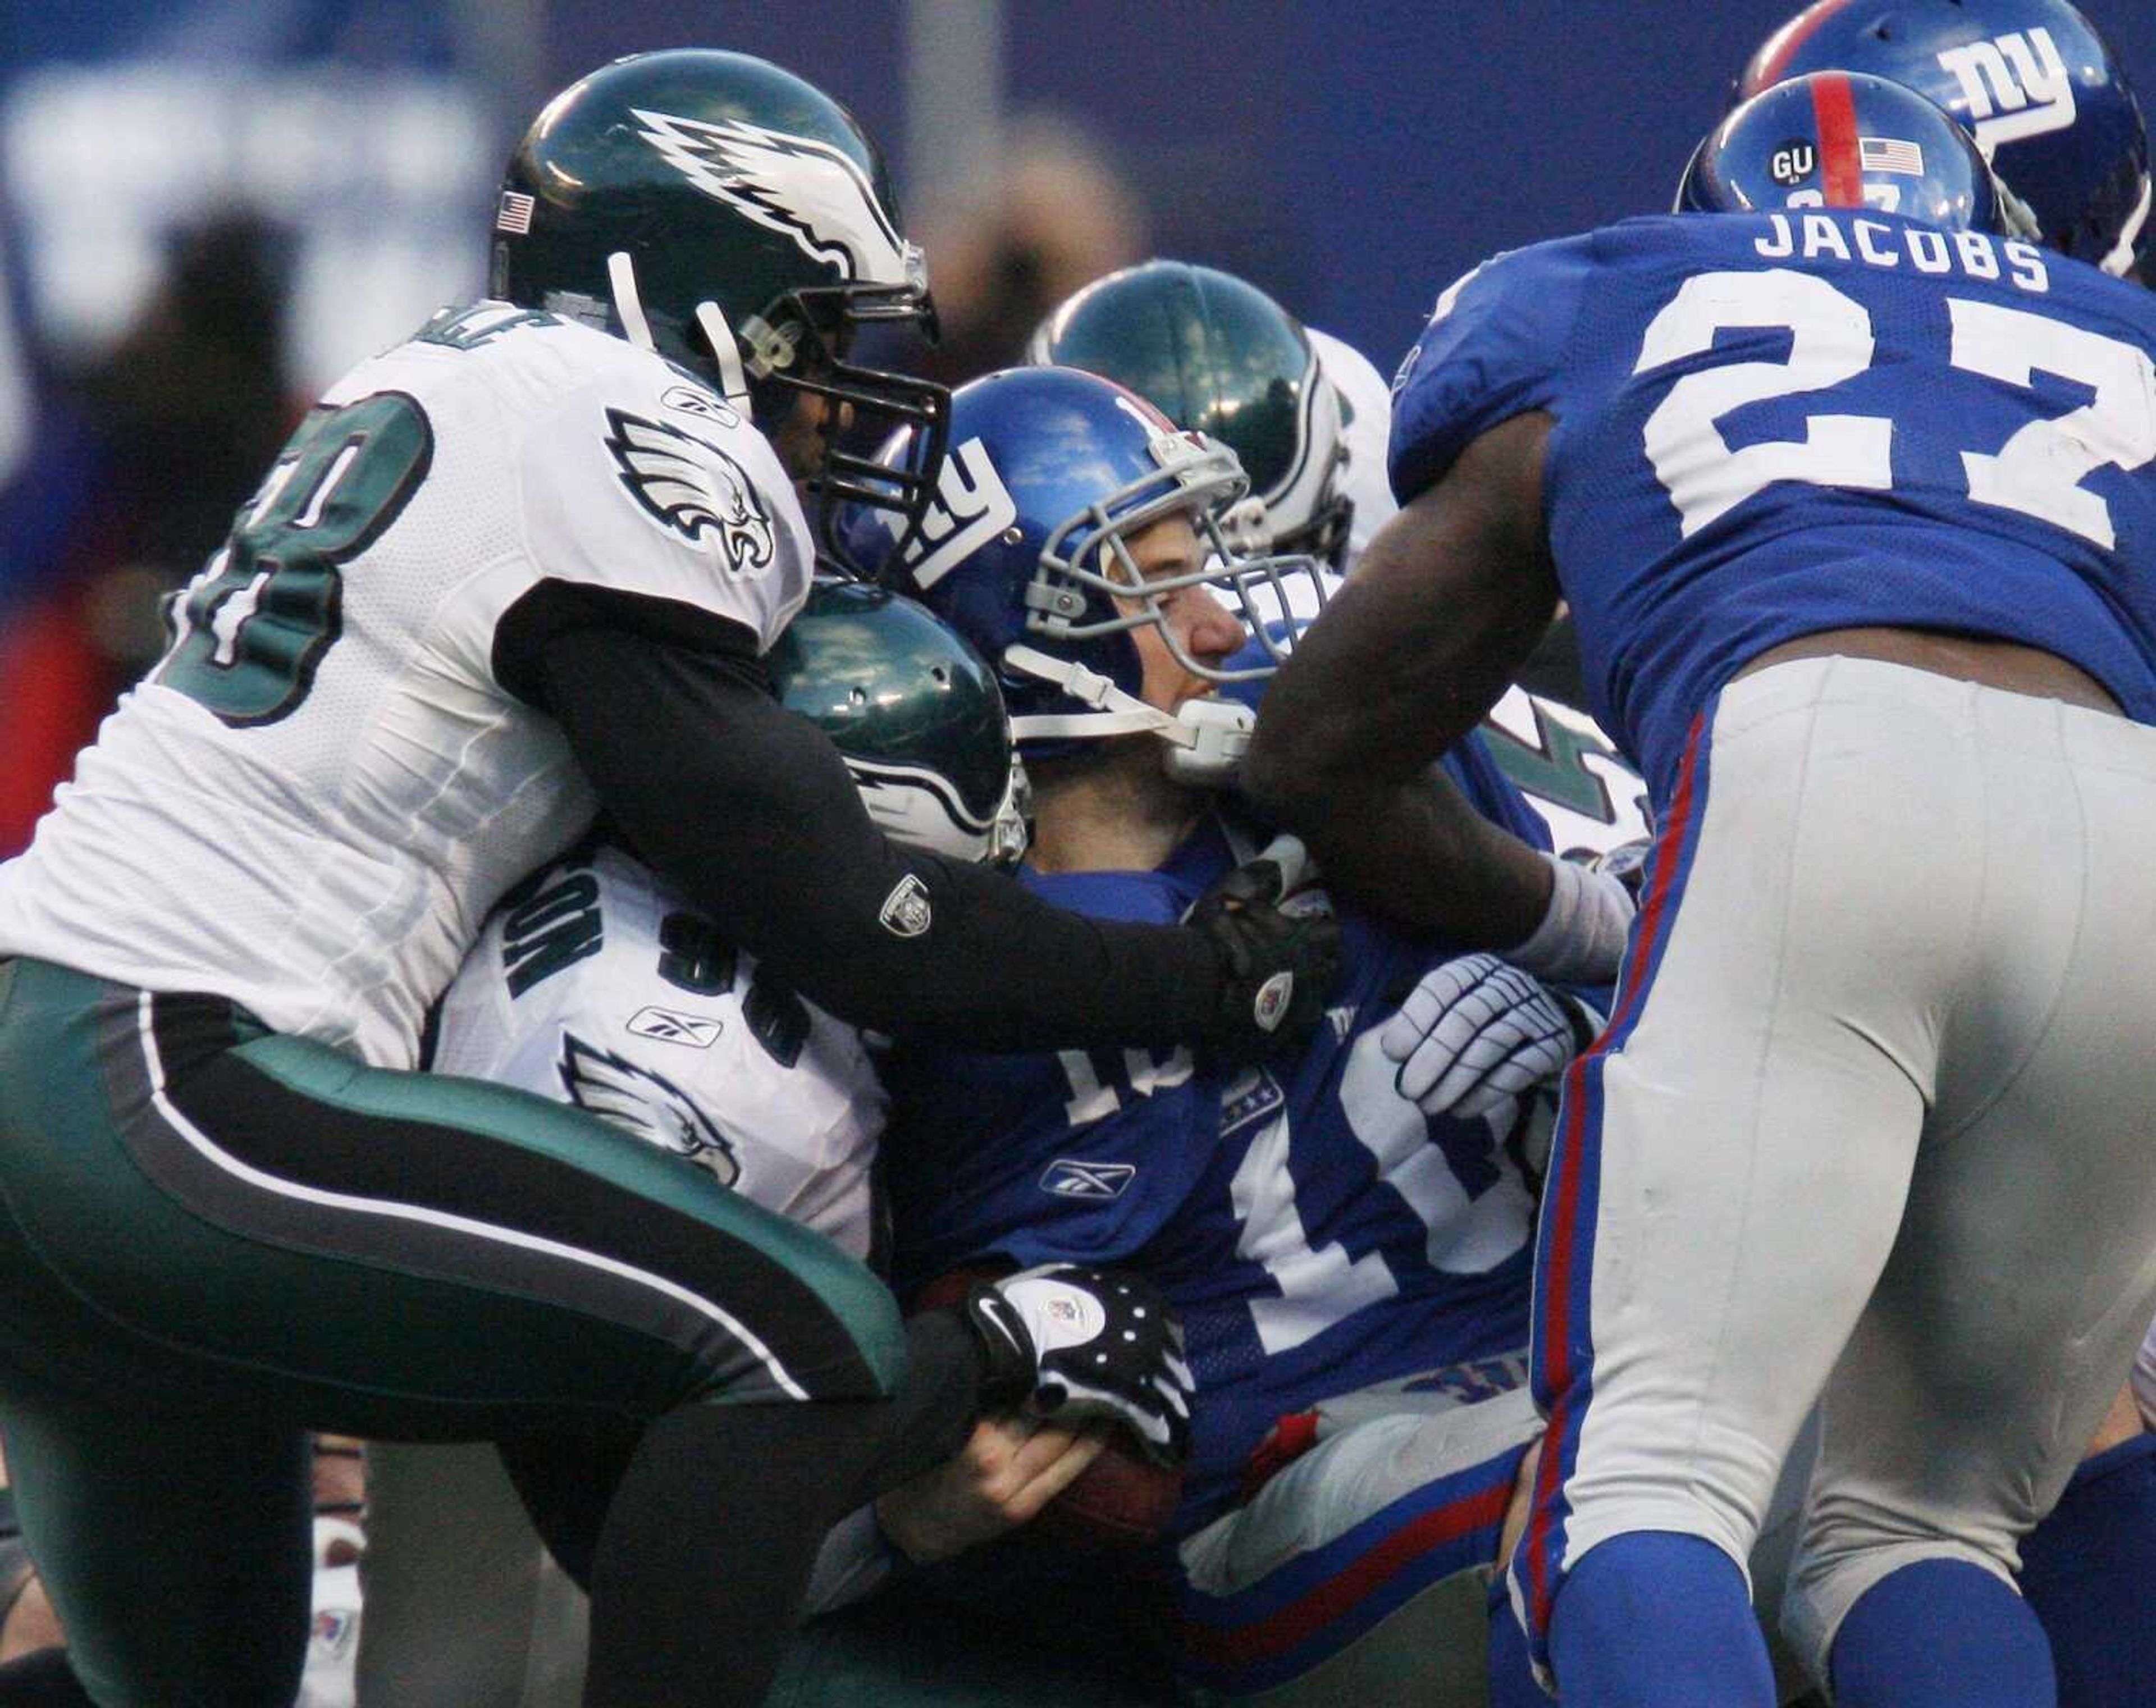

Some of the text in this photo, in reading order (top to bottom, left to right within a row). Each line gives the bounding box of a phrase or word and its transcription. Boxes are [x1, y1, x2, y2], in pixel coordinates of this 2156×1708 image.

[1773, 146, 1813, 179] GU
[1755, 213, 2049, 293] JACOBS
[1632, 268, 2156, 552] 27
